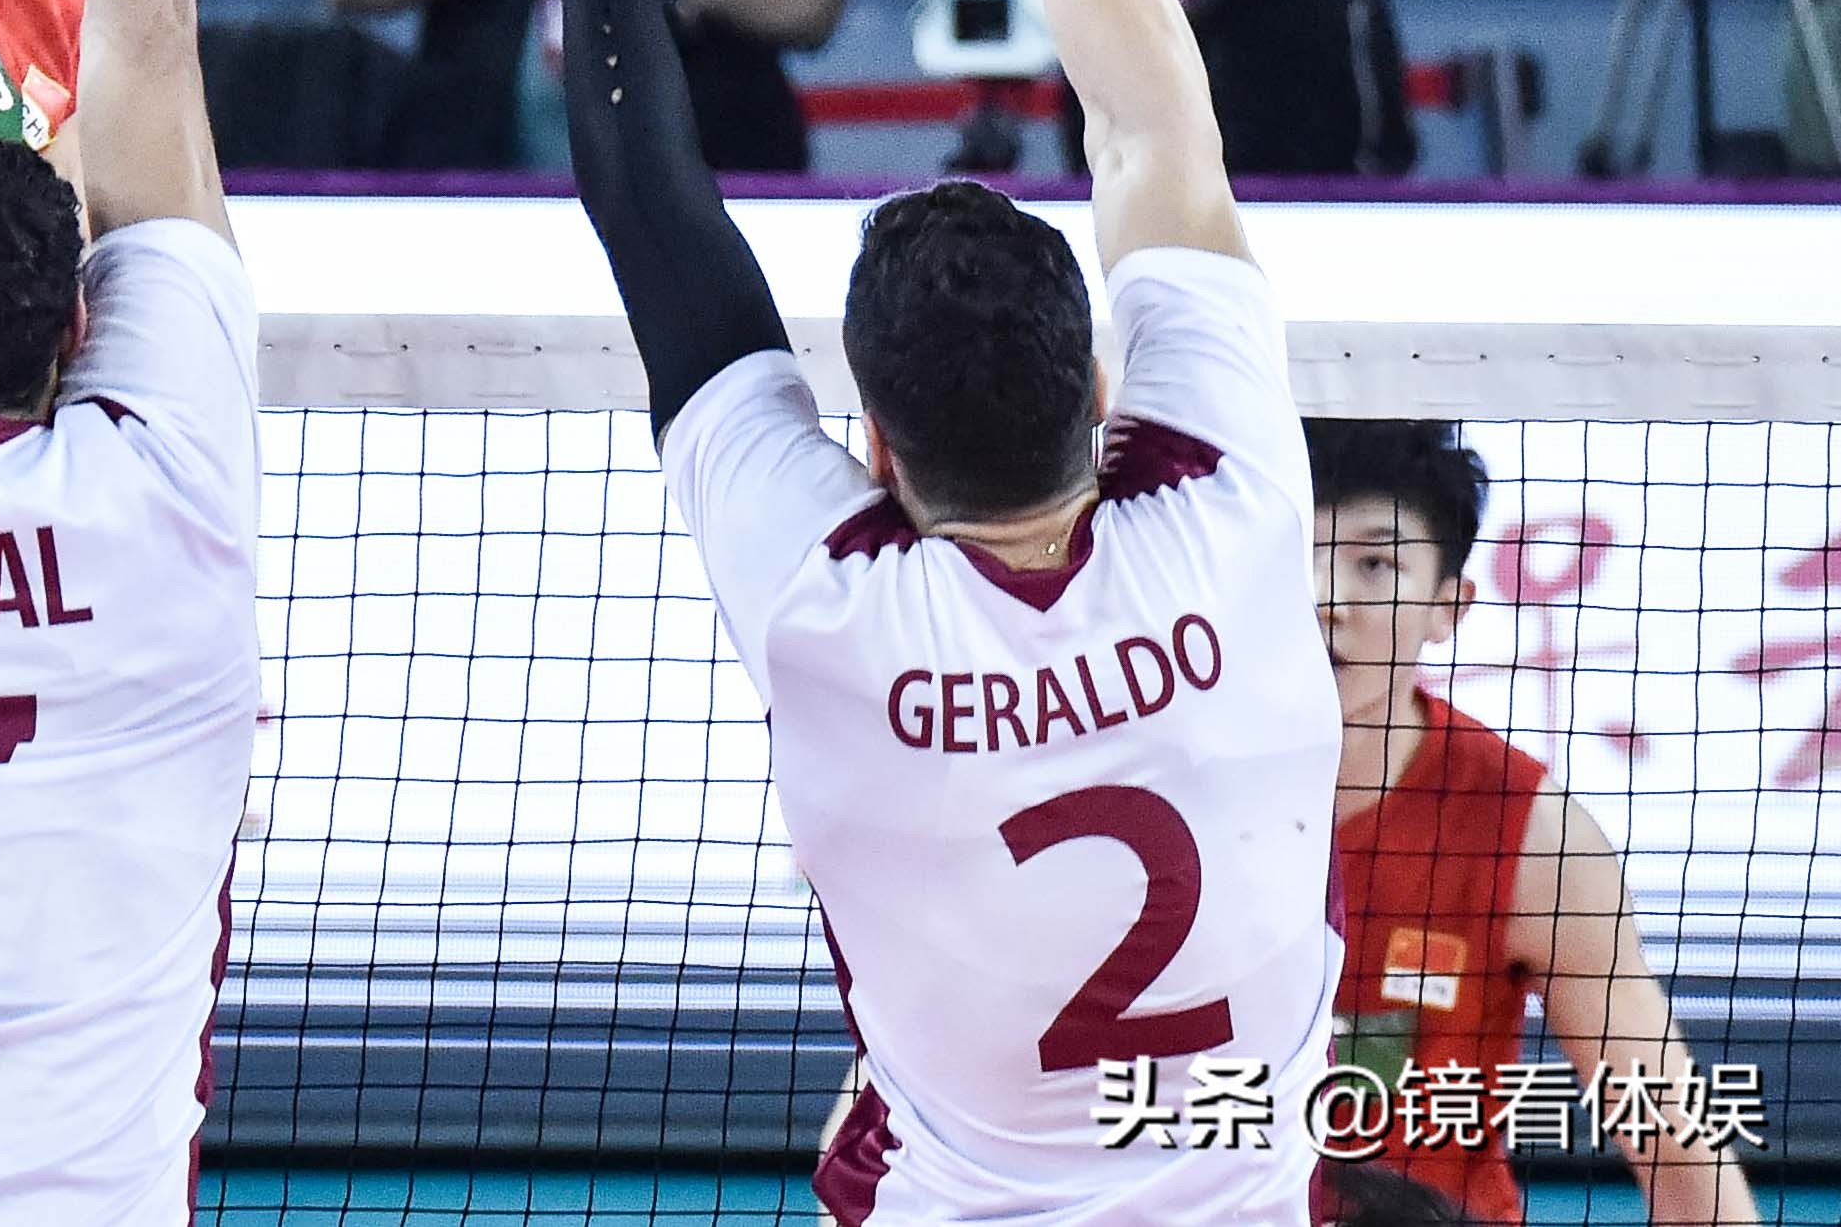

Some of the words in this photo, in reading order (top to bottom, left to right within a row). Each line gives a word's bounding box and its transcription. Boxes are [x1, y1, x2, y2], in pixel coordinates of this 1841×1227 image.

[21, 103, 44, 145] CH
[888, 614, 1222, 753] GERALDO
[998, 785, 1234, 1072] 2
